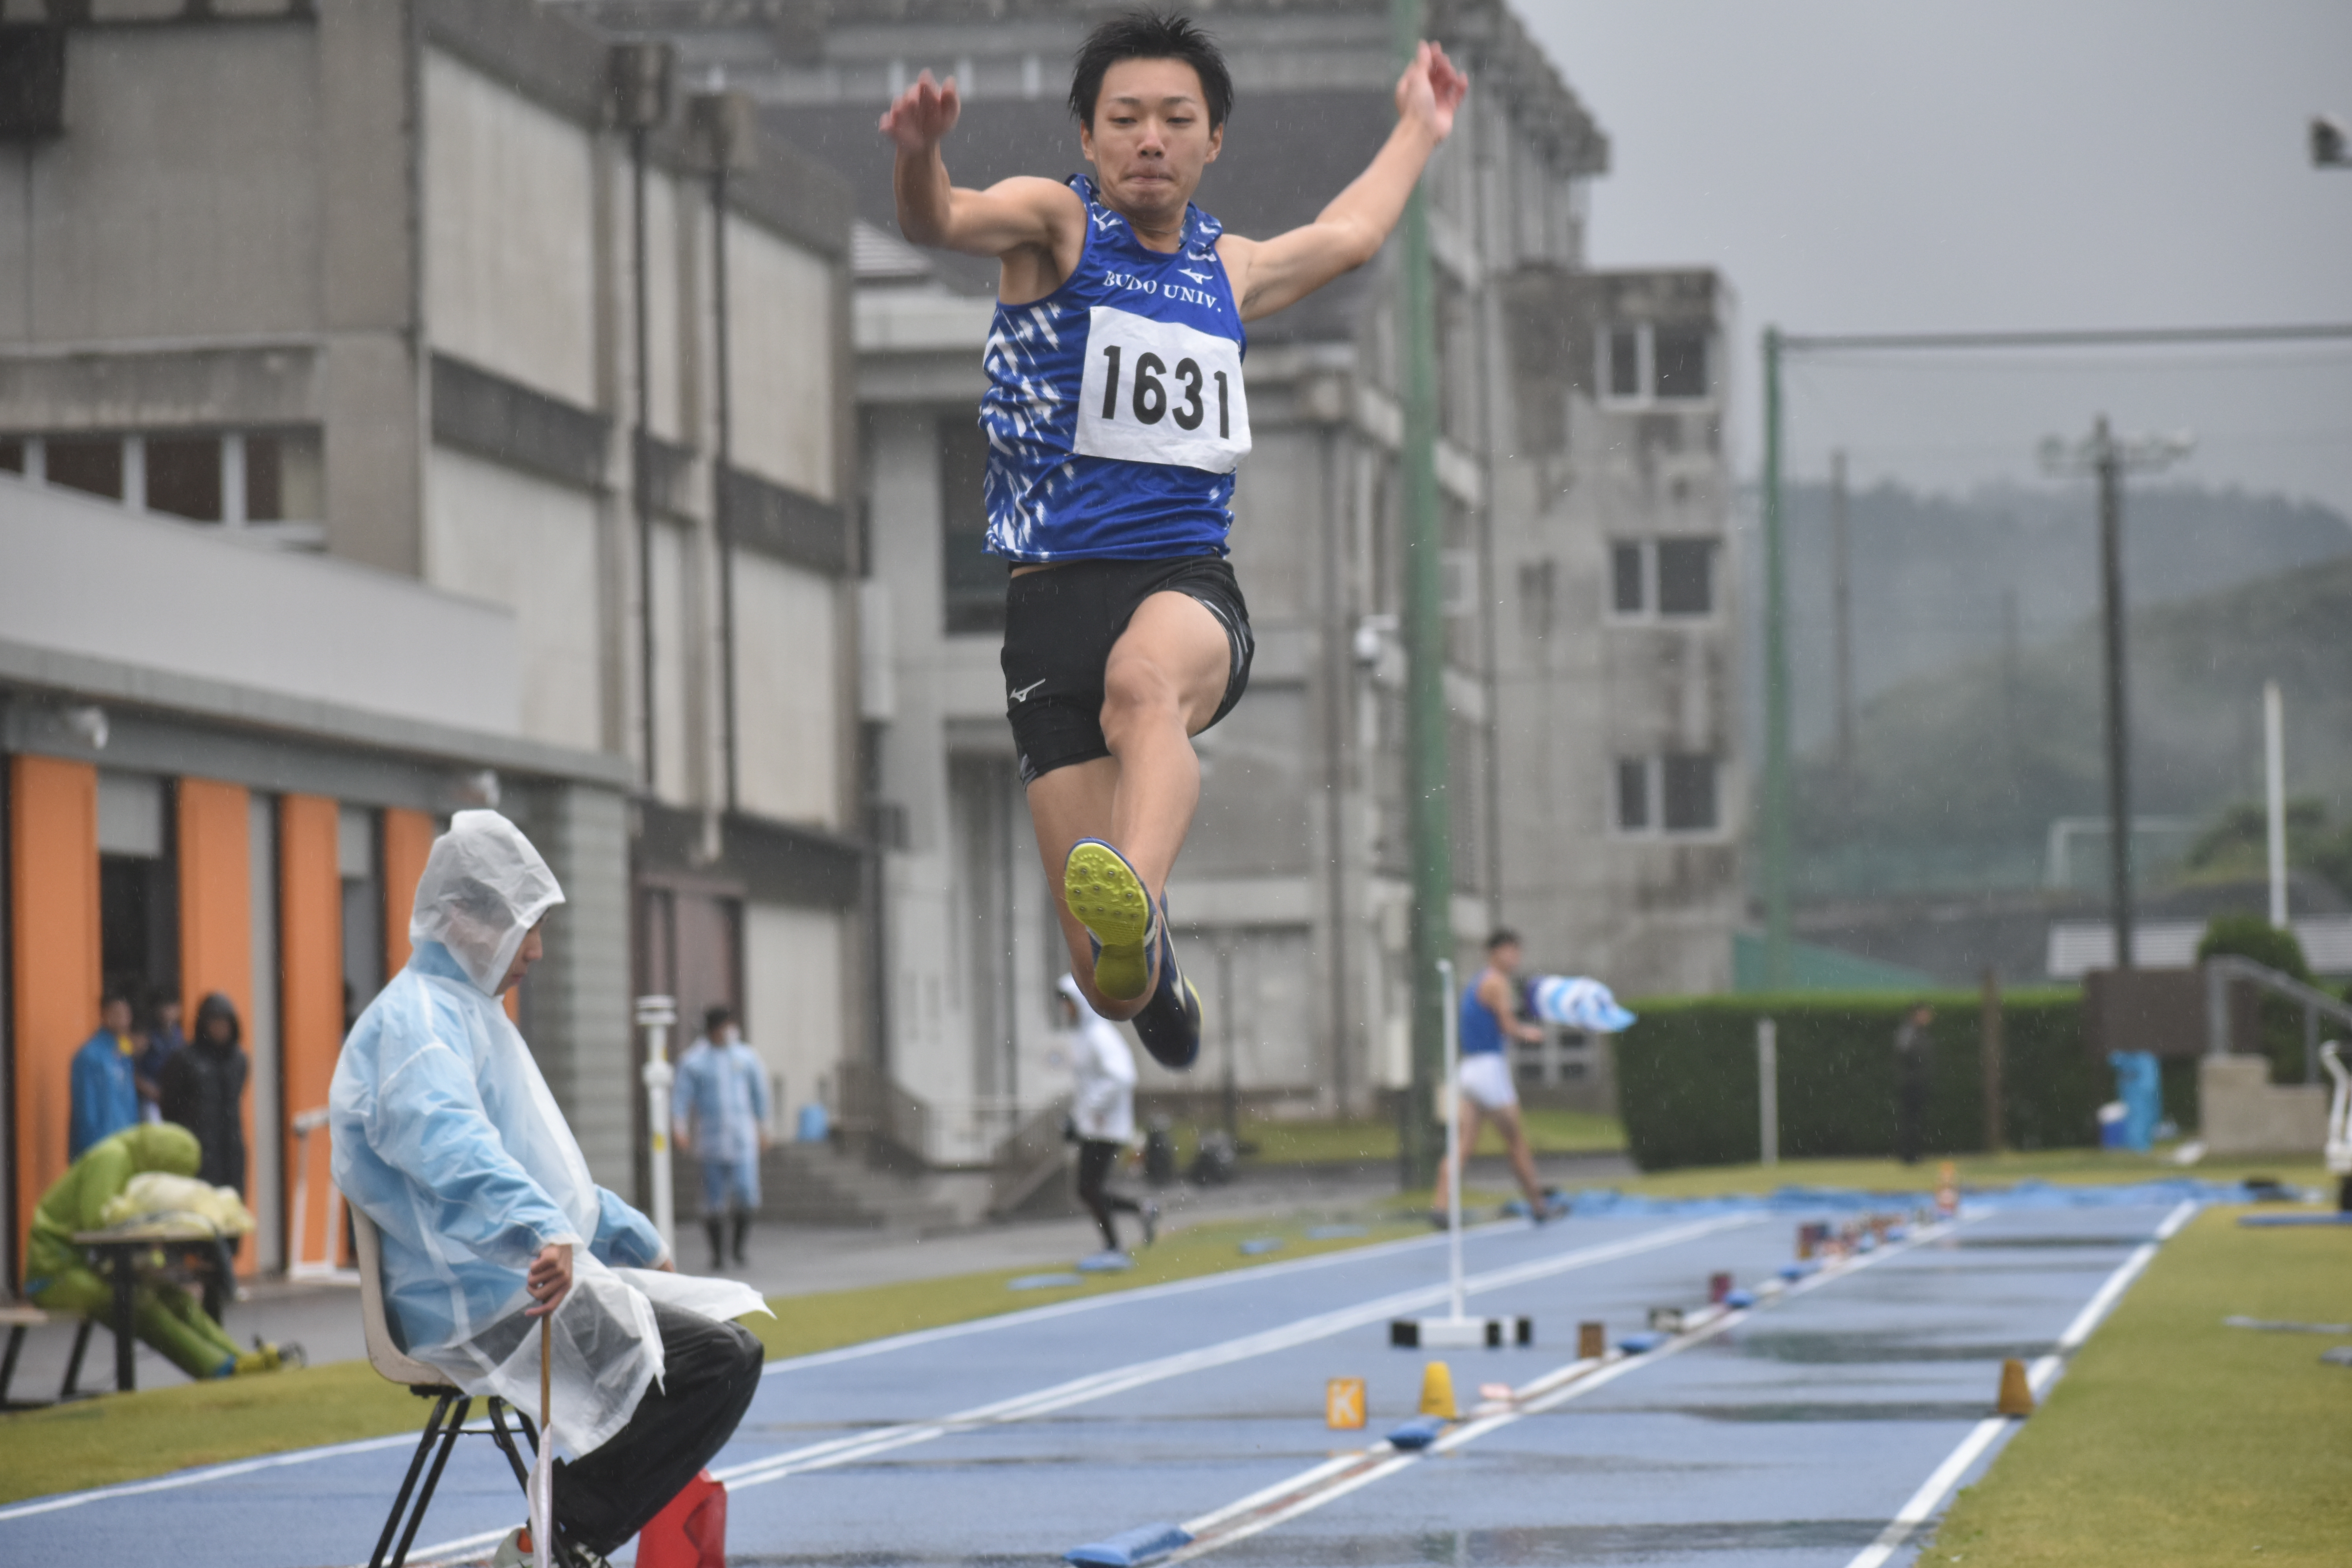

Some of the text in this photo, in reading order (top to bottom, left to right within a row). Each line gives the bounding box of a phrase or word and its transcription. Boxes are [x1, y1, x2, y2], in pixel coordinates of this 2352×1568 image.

[1103, 271, 1221, 312] BUDO UNIV.
[1102, 345, 1229, 439] 1631
[1332, 1382, 1358, 1424] K
